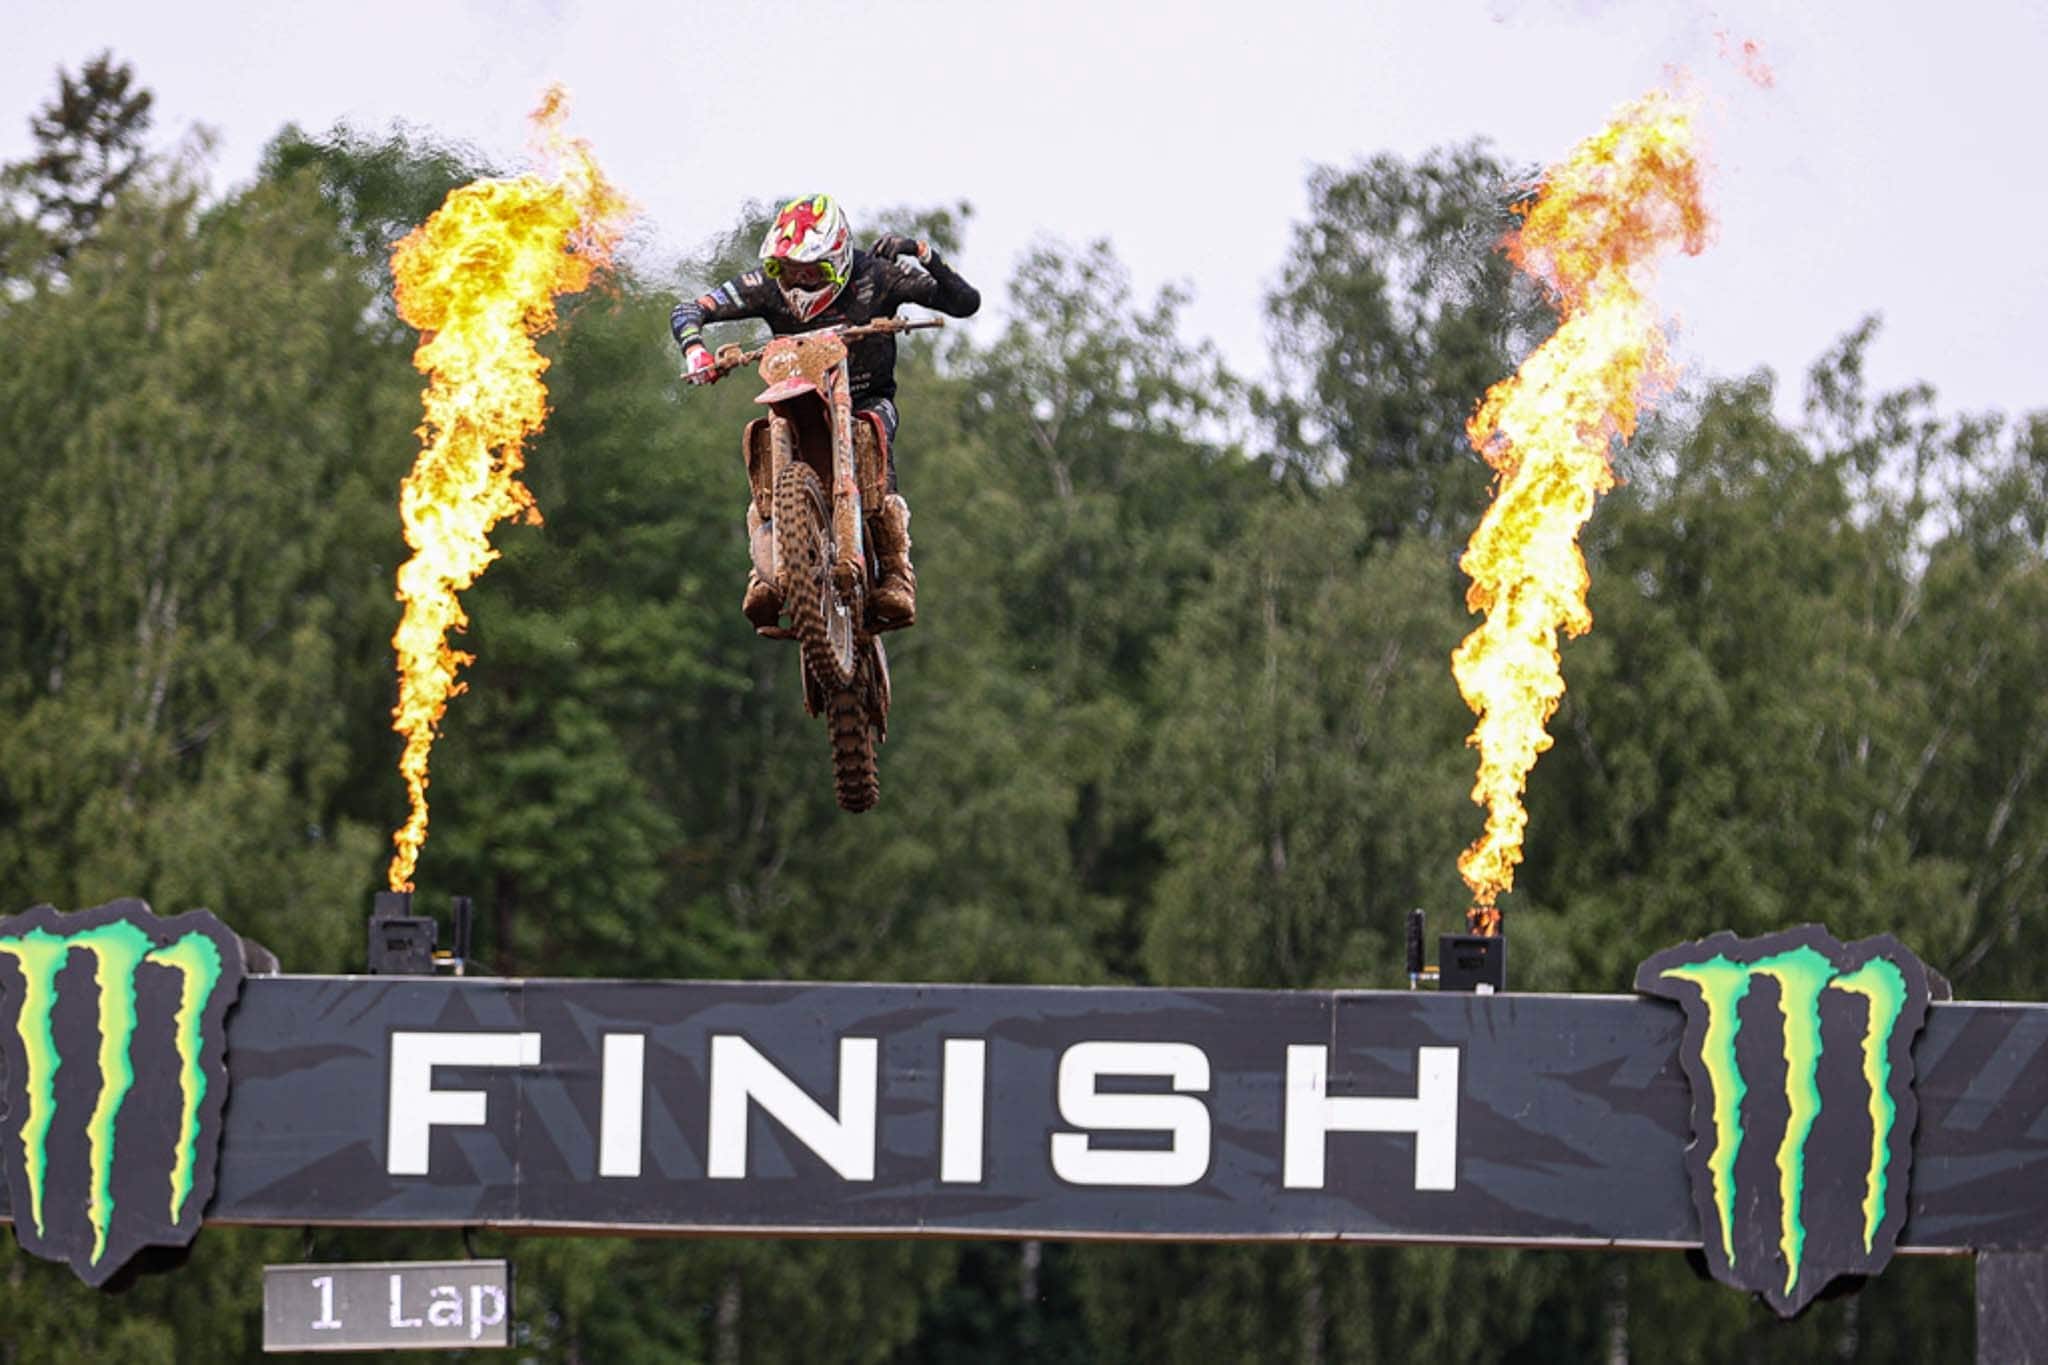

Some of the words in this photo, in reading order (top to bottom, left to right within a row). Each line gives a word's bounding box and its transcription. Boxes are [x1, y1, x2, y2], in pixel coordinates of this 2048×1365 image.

[387, 1031, 1459, 1191] FINISH
[311, 1275, 343, 1330] 1
[389, 1274, 506, 1340] Lap
